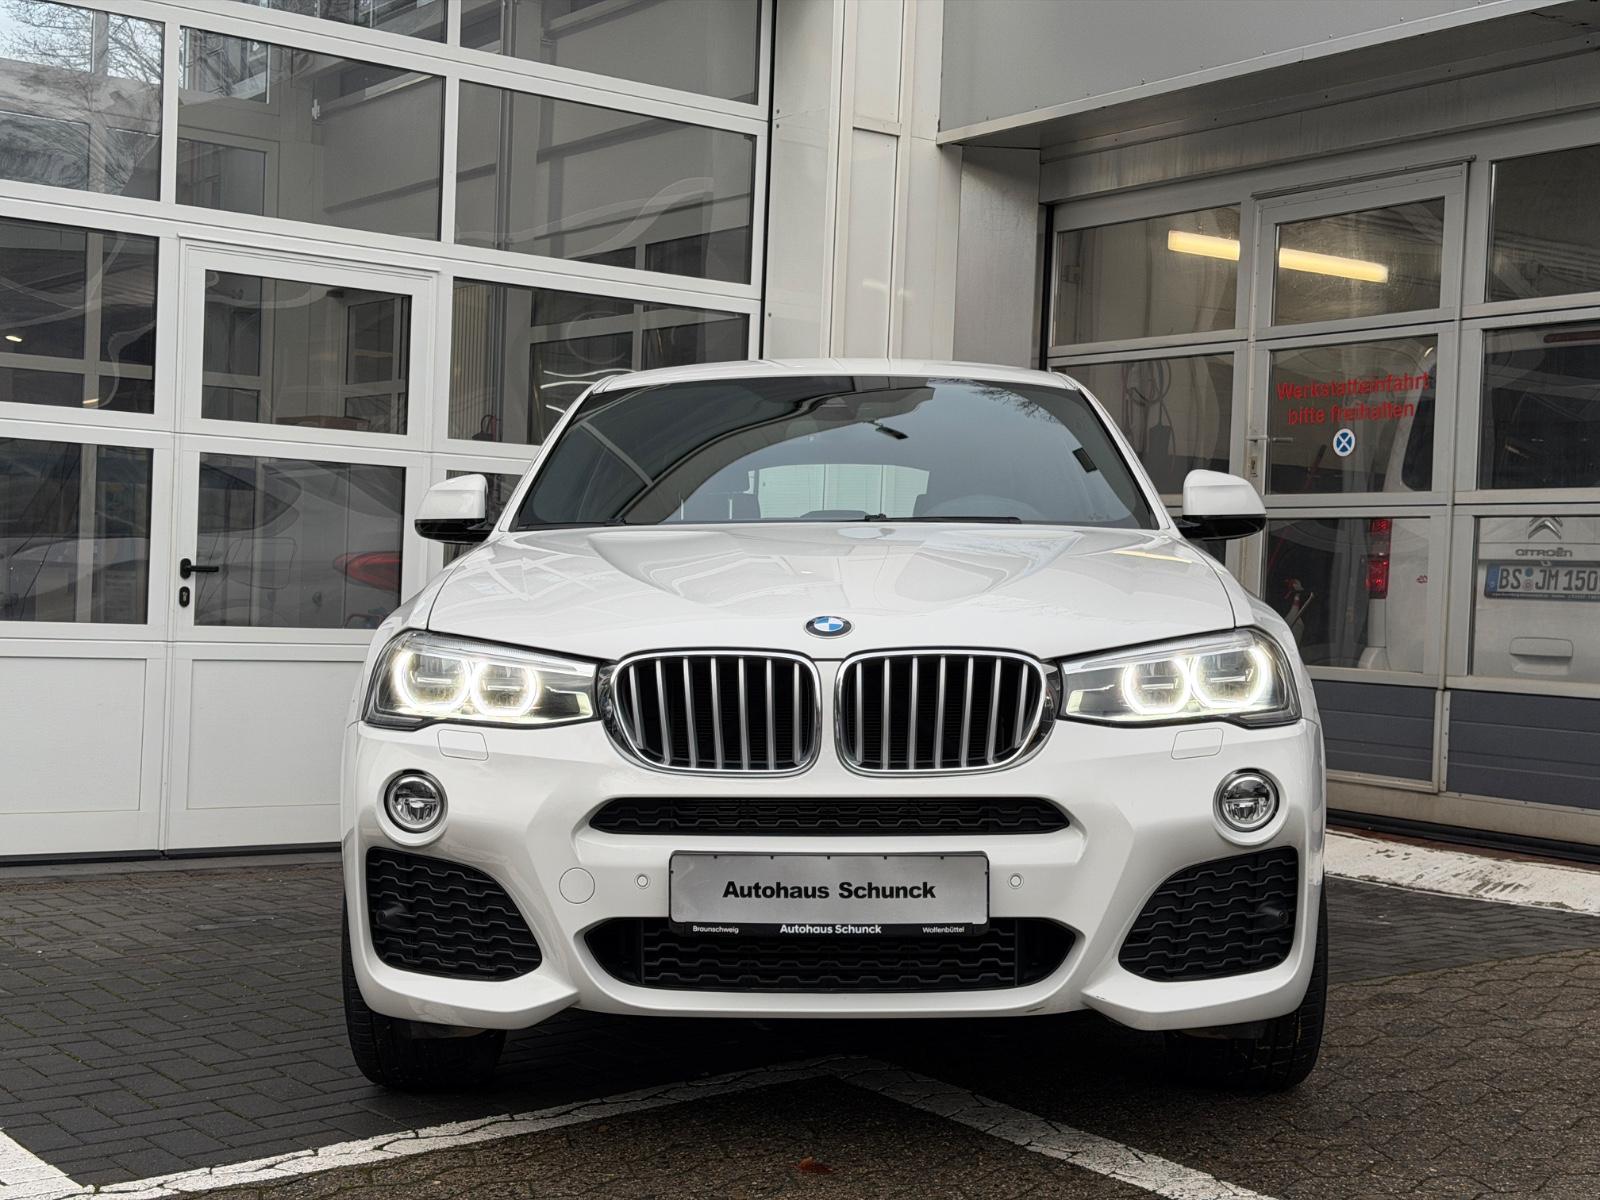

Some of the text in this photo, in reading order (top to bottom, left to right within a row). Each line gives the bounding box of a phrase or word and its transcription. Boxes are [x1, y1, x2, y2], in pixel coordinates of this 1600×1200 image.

[1276, 371, 1430, 400] Werkstatteinfahrt
[1288, 402, 1415, 425] bitte freihalten
[1498, 568, 1522, 590] BS
[1535, 569, 1559, 590] JM
[722, 881, 936, 899] Autohaus Schunck
[692, 925, 739, 934] Braunschweig
[780, 924, 882, 934] Autohaus Schunck
